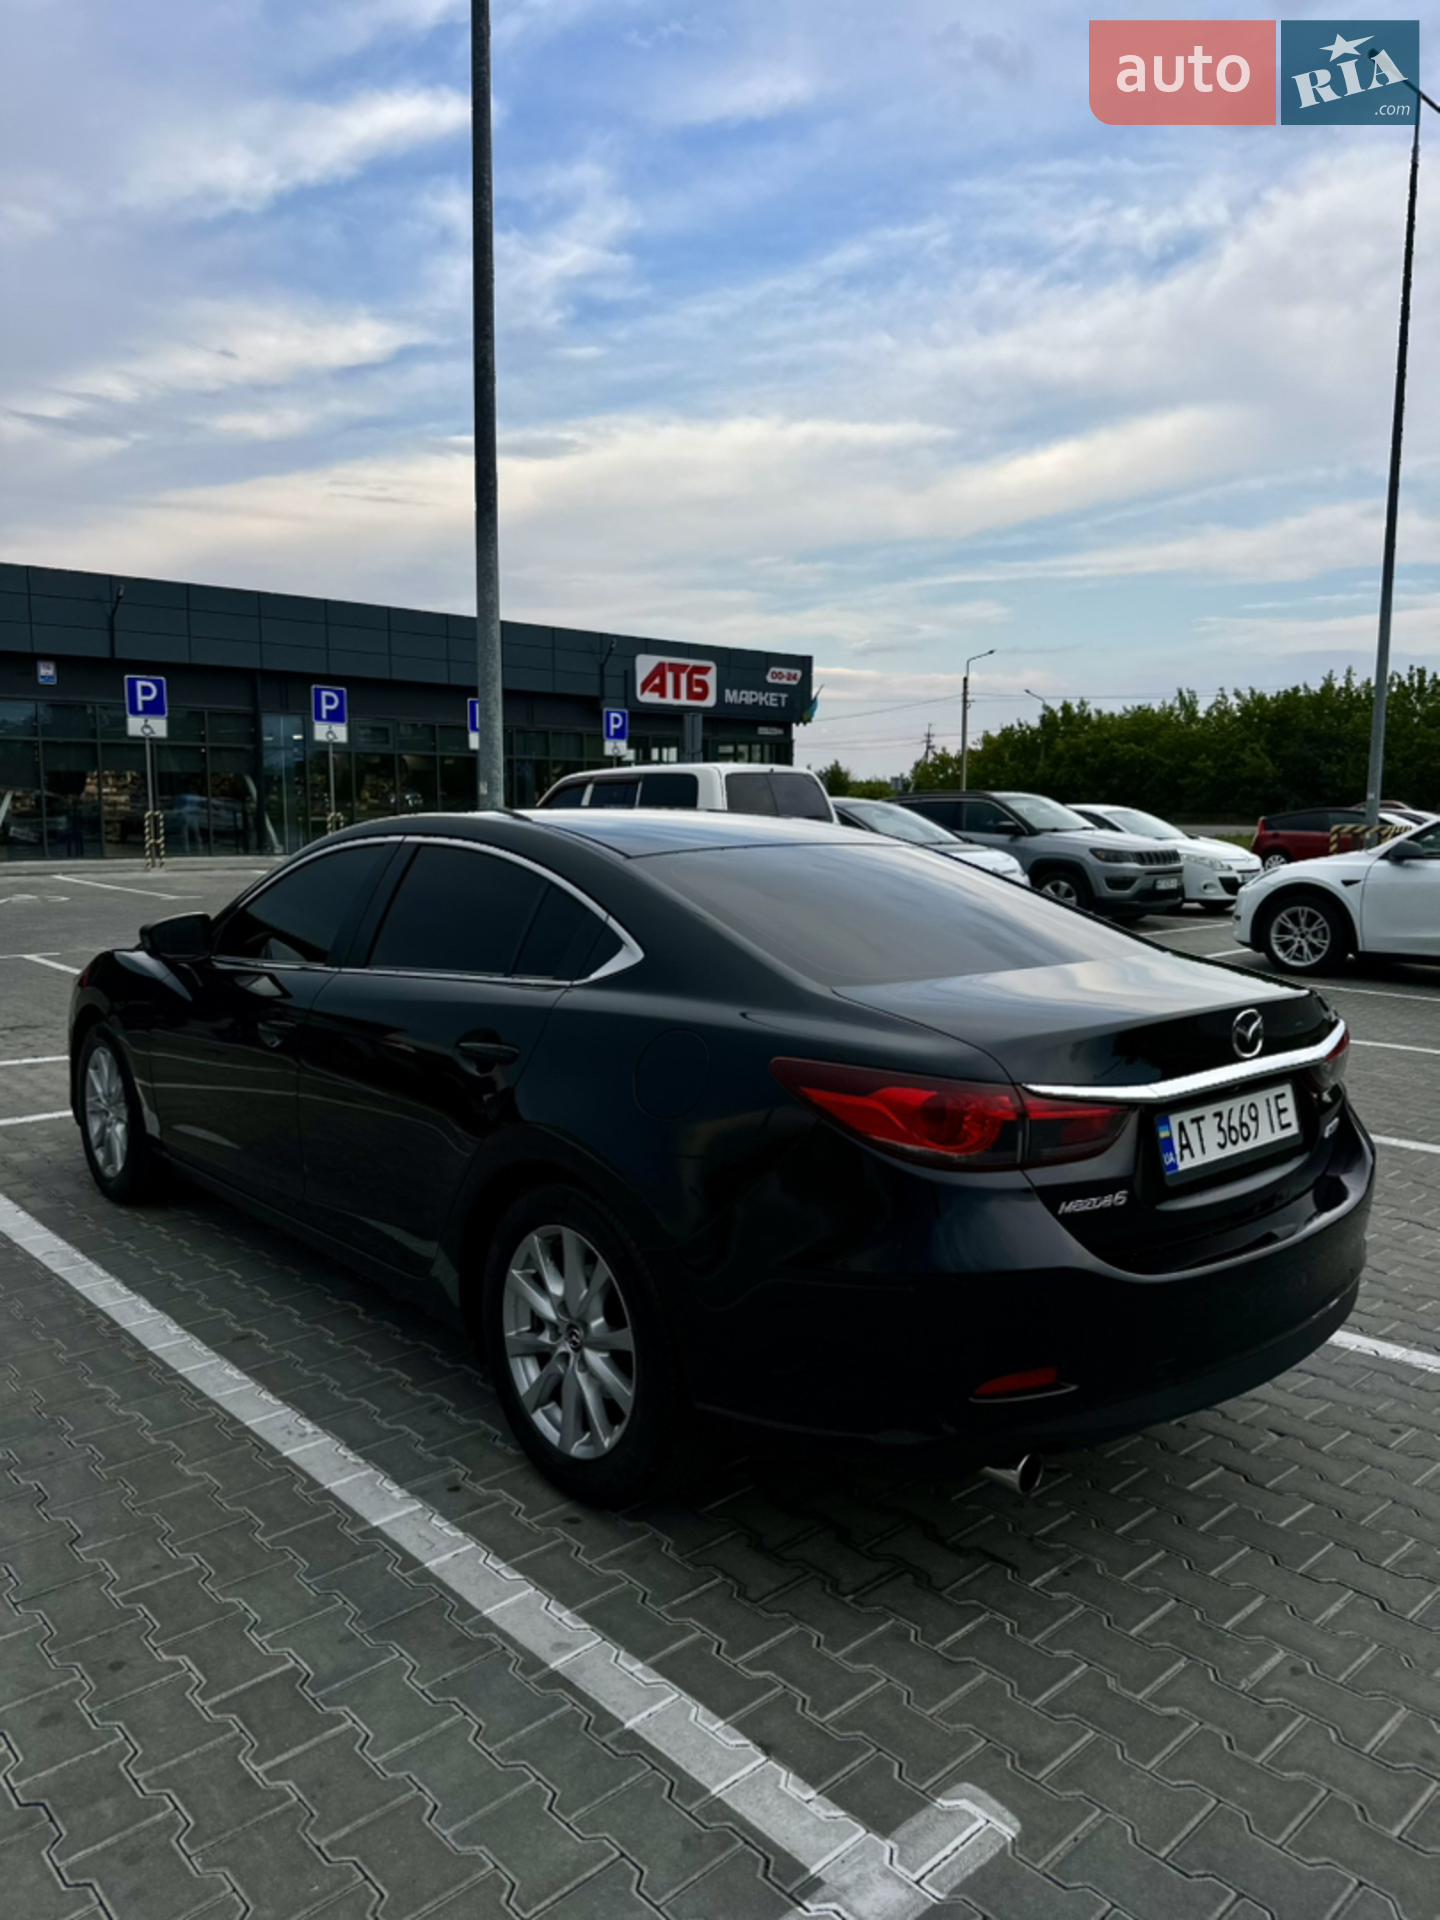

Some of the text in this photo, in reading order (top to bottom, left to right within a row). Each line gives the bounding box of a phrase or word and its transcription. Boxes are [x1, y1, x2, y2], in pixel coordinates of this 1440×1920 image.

[136, 680, 158, 712] P
[640, 661, 712, 702] АТБ
[321, 690, 339, 719] P
[724, 688, 788, 707] МАРКЕТ
[609, 712, 623, 737] P
[1178, 1115, 1206, 1162] AT
[1212, 1102, 1259, 1150] 3669
[1265, 1092, 1292, 1134] IE
